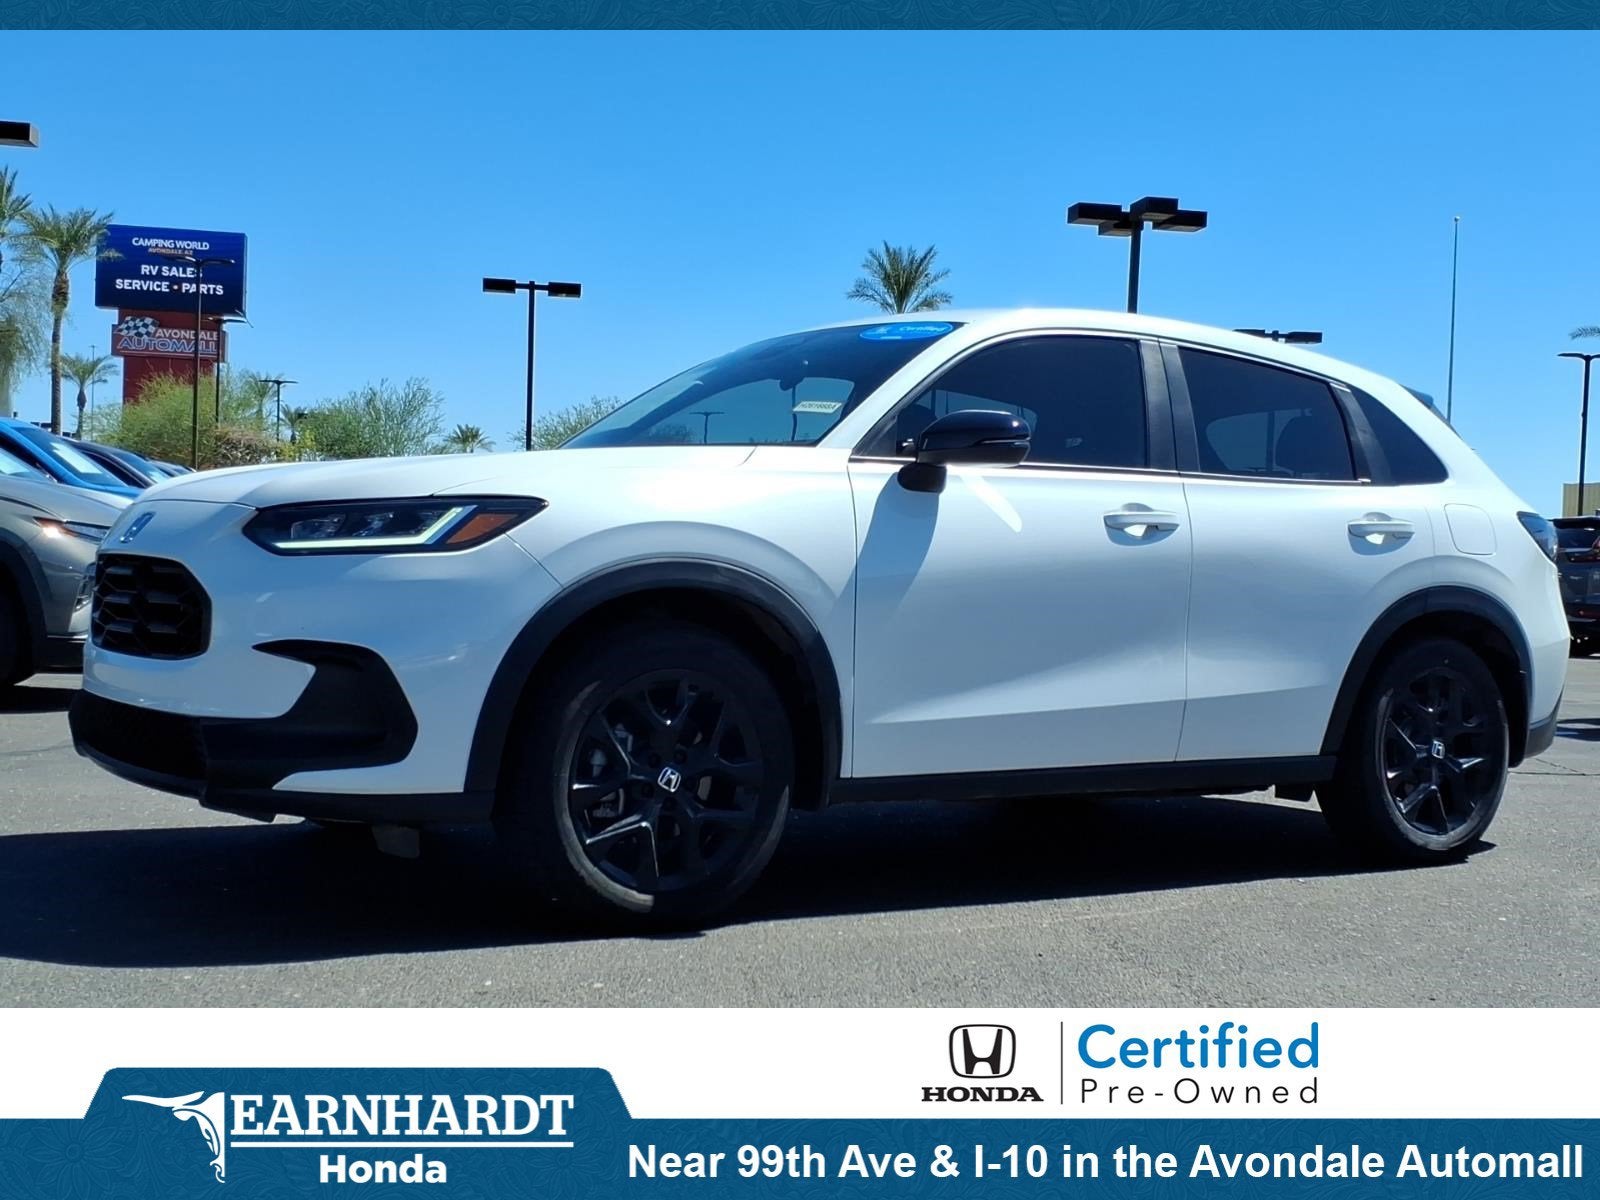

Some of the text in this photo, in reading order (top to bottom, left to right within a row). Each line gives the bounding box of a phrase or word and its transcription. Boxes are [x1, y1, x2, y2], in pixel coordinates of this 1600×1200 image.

[132, 237, 210, 250] CAMPING WORLD
[141, 264, 159, 276] RV
[115, 279, 224, 295] SERVICE PARTS
